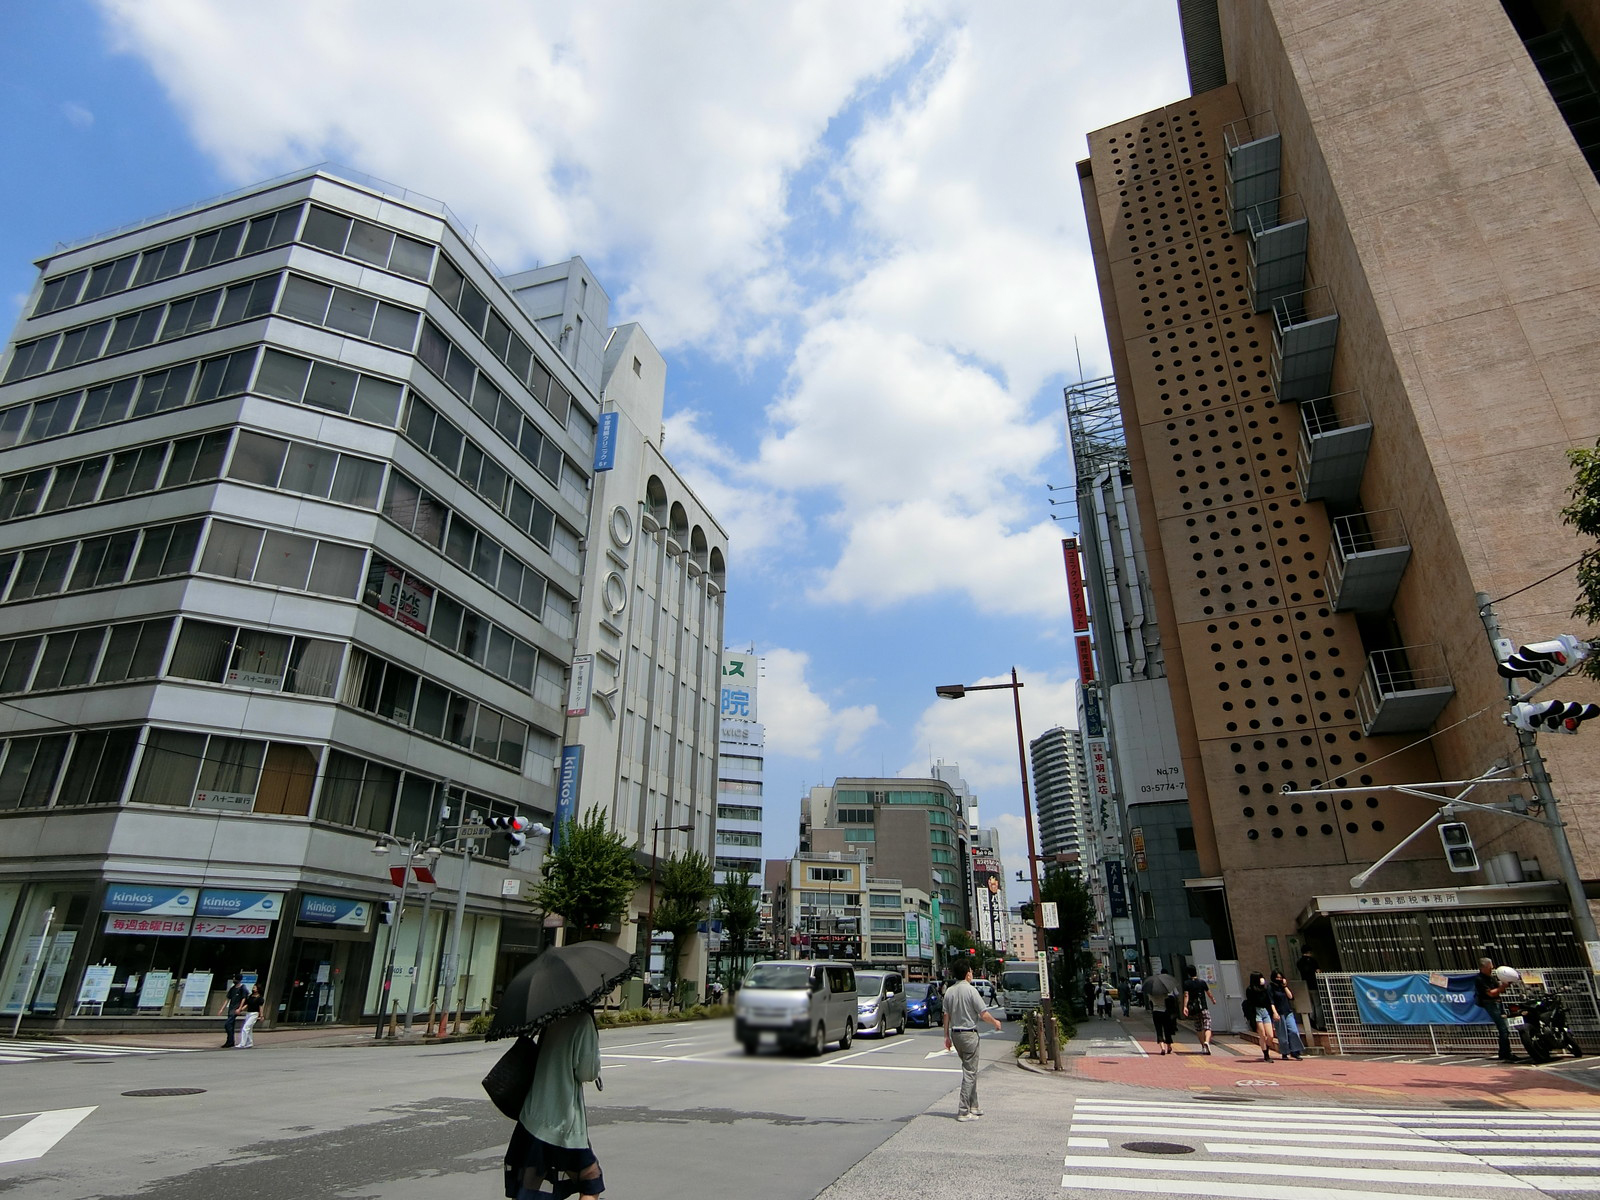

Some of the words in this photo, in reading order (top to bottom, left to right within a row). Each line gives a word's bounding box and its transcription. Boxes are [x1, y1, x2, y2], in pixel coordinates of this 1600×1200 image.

[560, 756, 576, 806] kinko's
[1110, 863, 1120, 893] 大戸屋
[113, 892, 154, 903] kinko's
[203, 896, 241, 907] kinko's
[1371, 893, 1456, 905] 豊島都税事務所
[307, 900, 337, 913] kinko's
[113, 919, 186, 932] 毎週金曜日は
[195, 922, 266, 935] キンコーズの日
[1403, 993, 1437, 1004] TOKYO
[1440, 993, 1466, 1003] 2020
